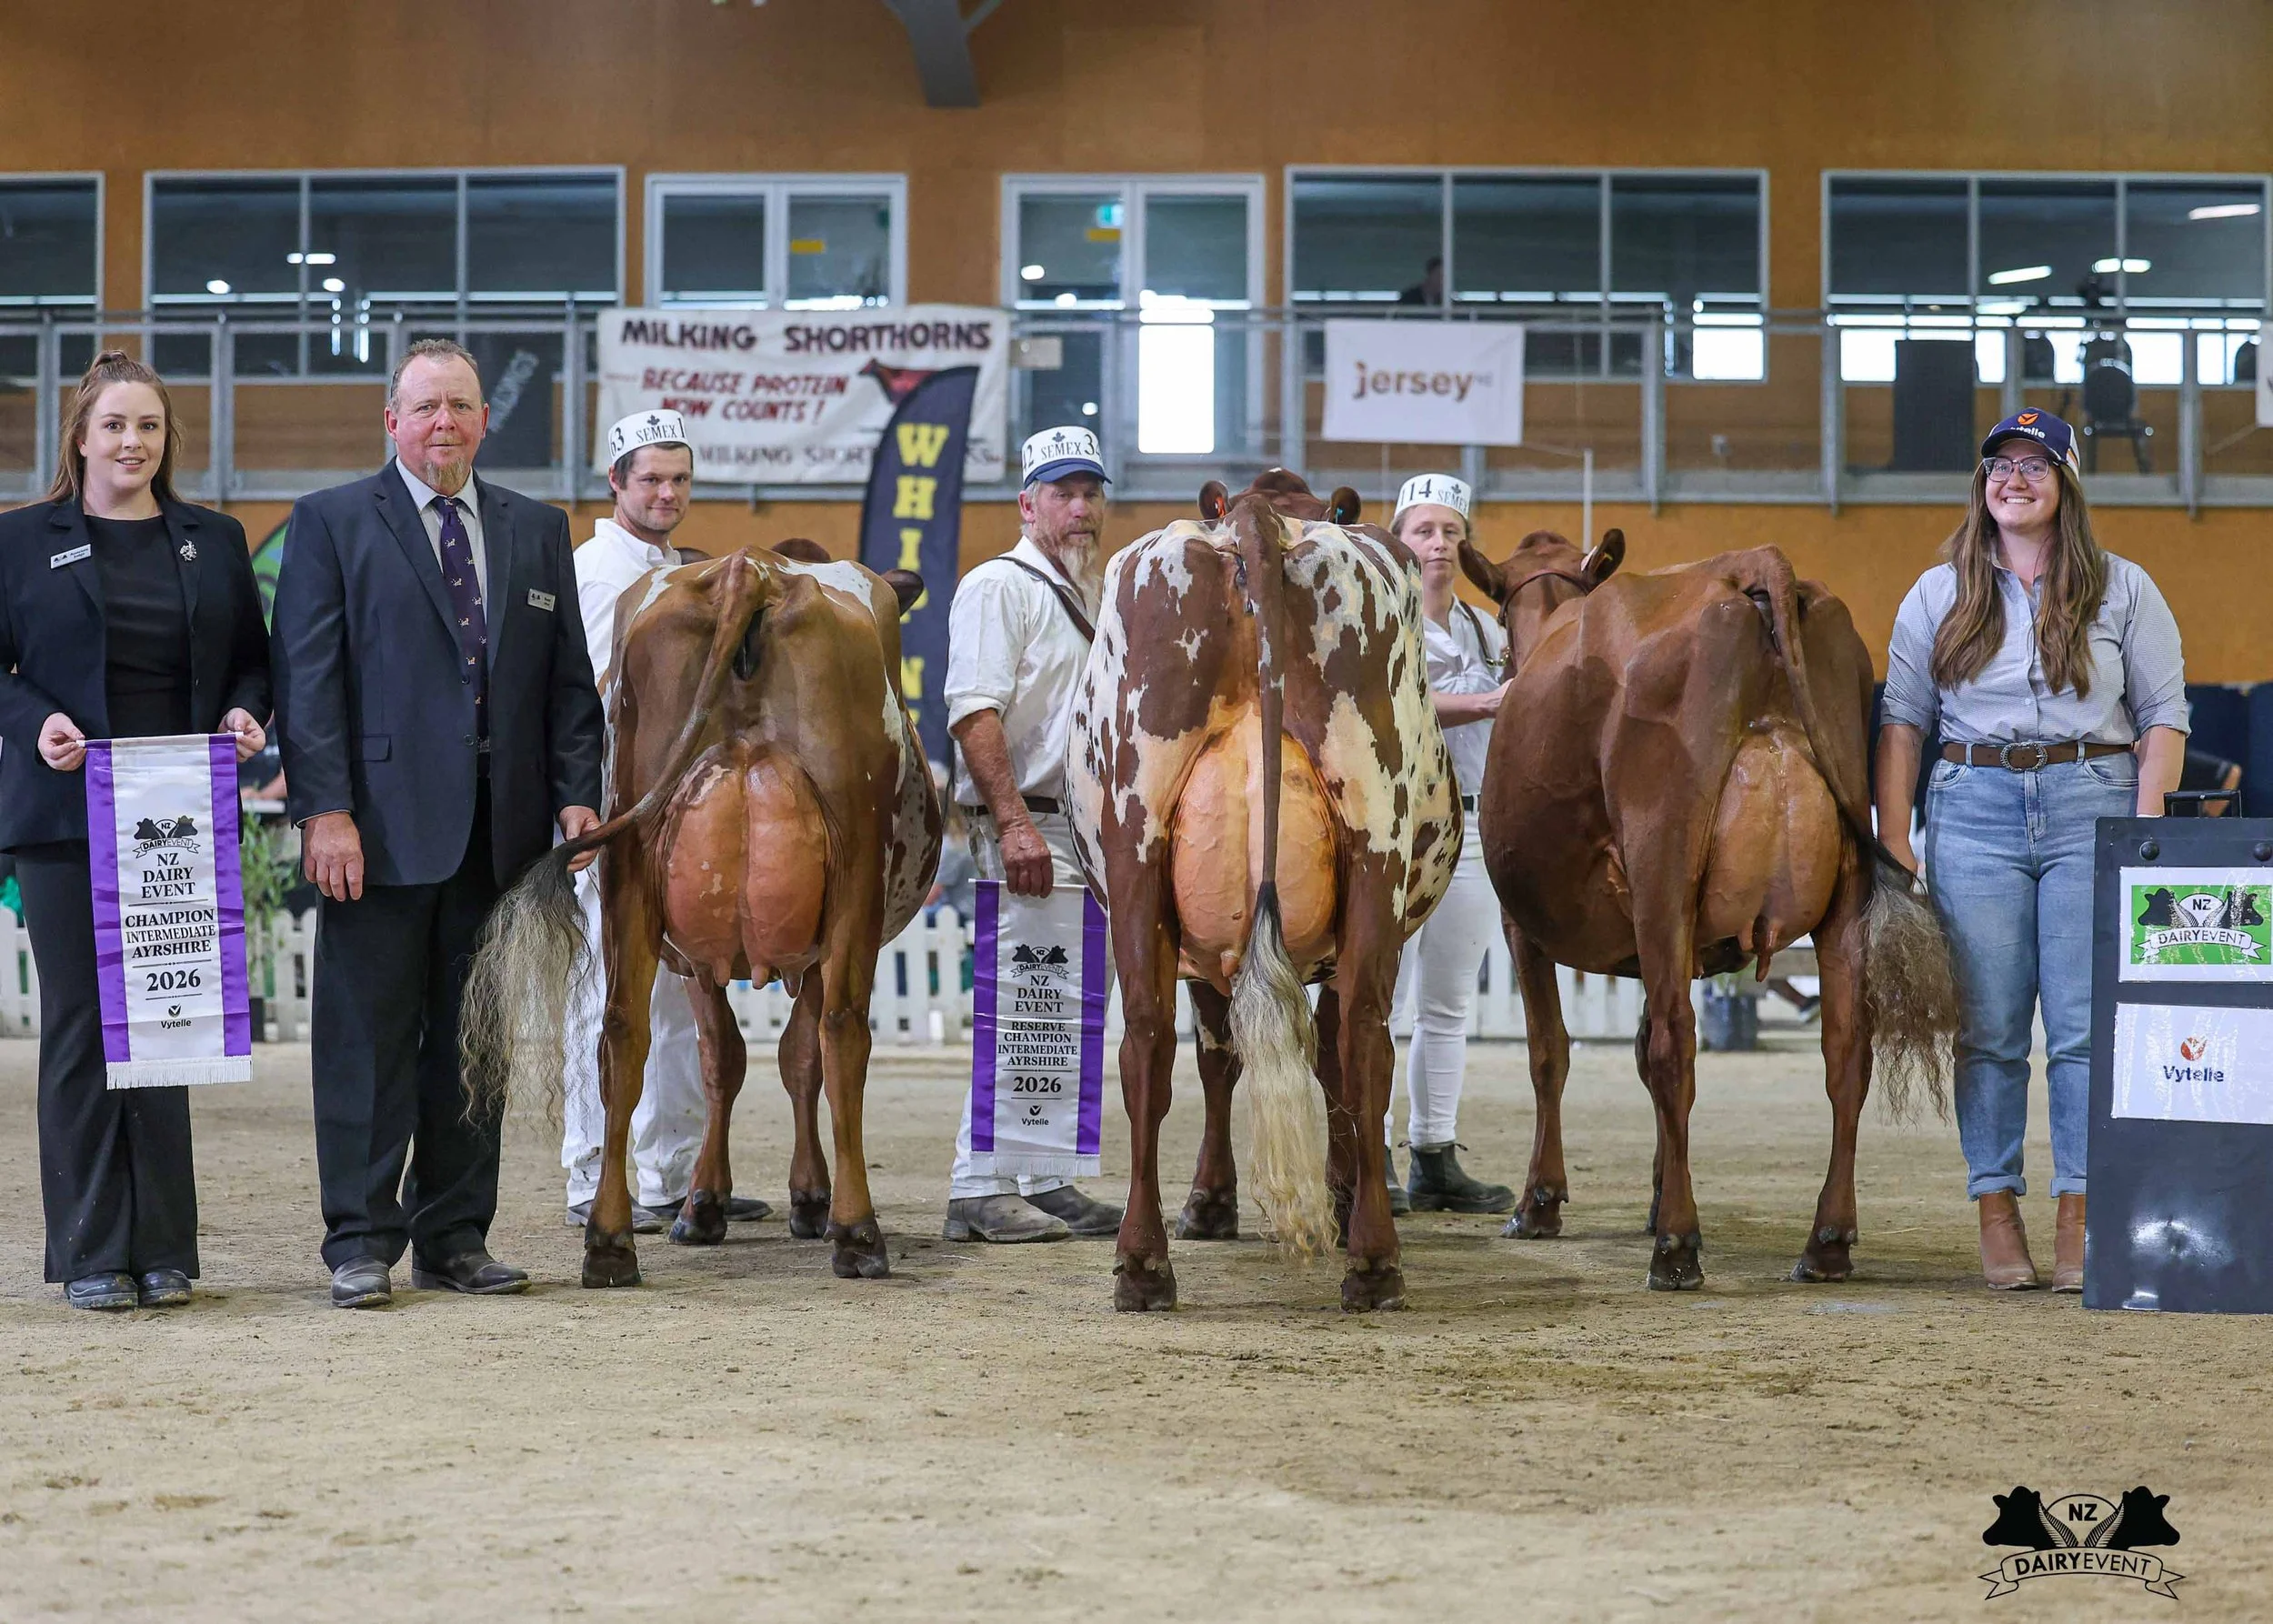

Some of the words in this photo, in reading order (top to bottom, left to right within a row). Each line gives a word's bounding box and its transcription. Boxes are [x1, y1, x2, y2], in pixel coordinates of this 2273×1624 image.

[622, 320, 757, 351] MILKING
[784, 323, 991, 353] SHORTHORNS
[642, 367, 744, 395] BECAUSE
[753, 374, 849, 396] PROTEIN
[1352, 360, 1474, 403] jersey
[636, 424, 677, 444] SEMEX
[2010, 426, 2046, 438] telle
[1040, 441, 1082, 461] SEMEX
[143, 838, 192, 850] DAIRYEVENT
[157, 852, 179, 867] NZ
[143, 867, 194, 883] DAIRY
[141, 882, 195, 899] EVENT
[2192, 898, 2211, 911] NZ
[125, 909, 215, 928] CHAMPION
[126, 924, 216, 944] INTERMEDIATE
[2158, 929, 2246, 946] DAIRYEVENT
[132, 939, 212, 959] AYRSHIRE
[145, 968, 201, 992] 2026
[1030, 975, 1050, 987] NZ
[1016, 987, 1062, 1000] DAIRY
[1015, 1001, 1064, 1013] EVENT
[160, 1018, 192, 1029] Vytelle
[1011, 1021, 1066, 1032] RESERVE
[1004, 1033, 1072, 1043] CHAMPION
[997, 1044, 1077, 1056] INTERMEDIATE
[1007, 1056, 1068, 1067] AYRSHIRE
[2163, 1065, 2225, 1083] Vytelle
[1013, 1076, 1062, 1093] 2026
[1021, 1118, 1049, 1127] Vytelle
